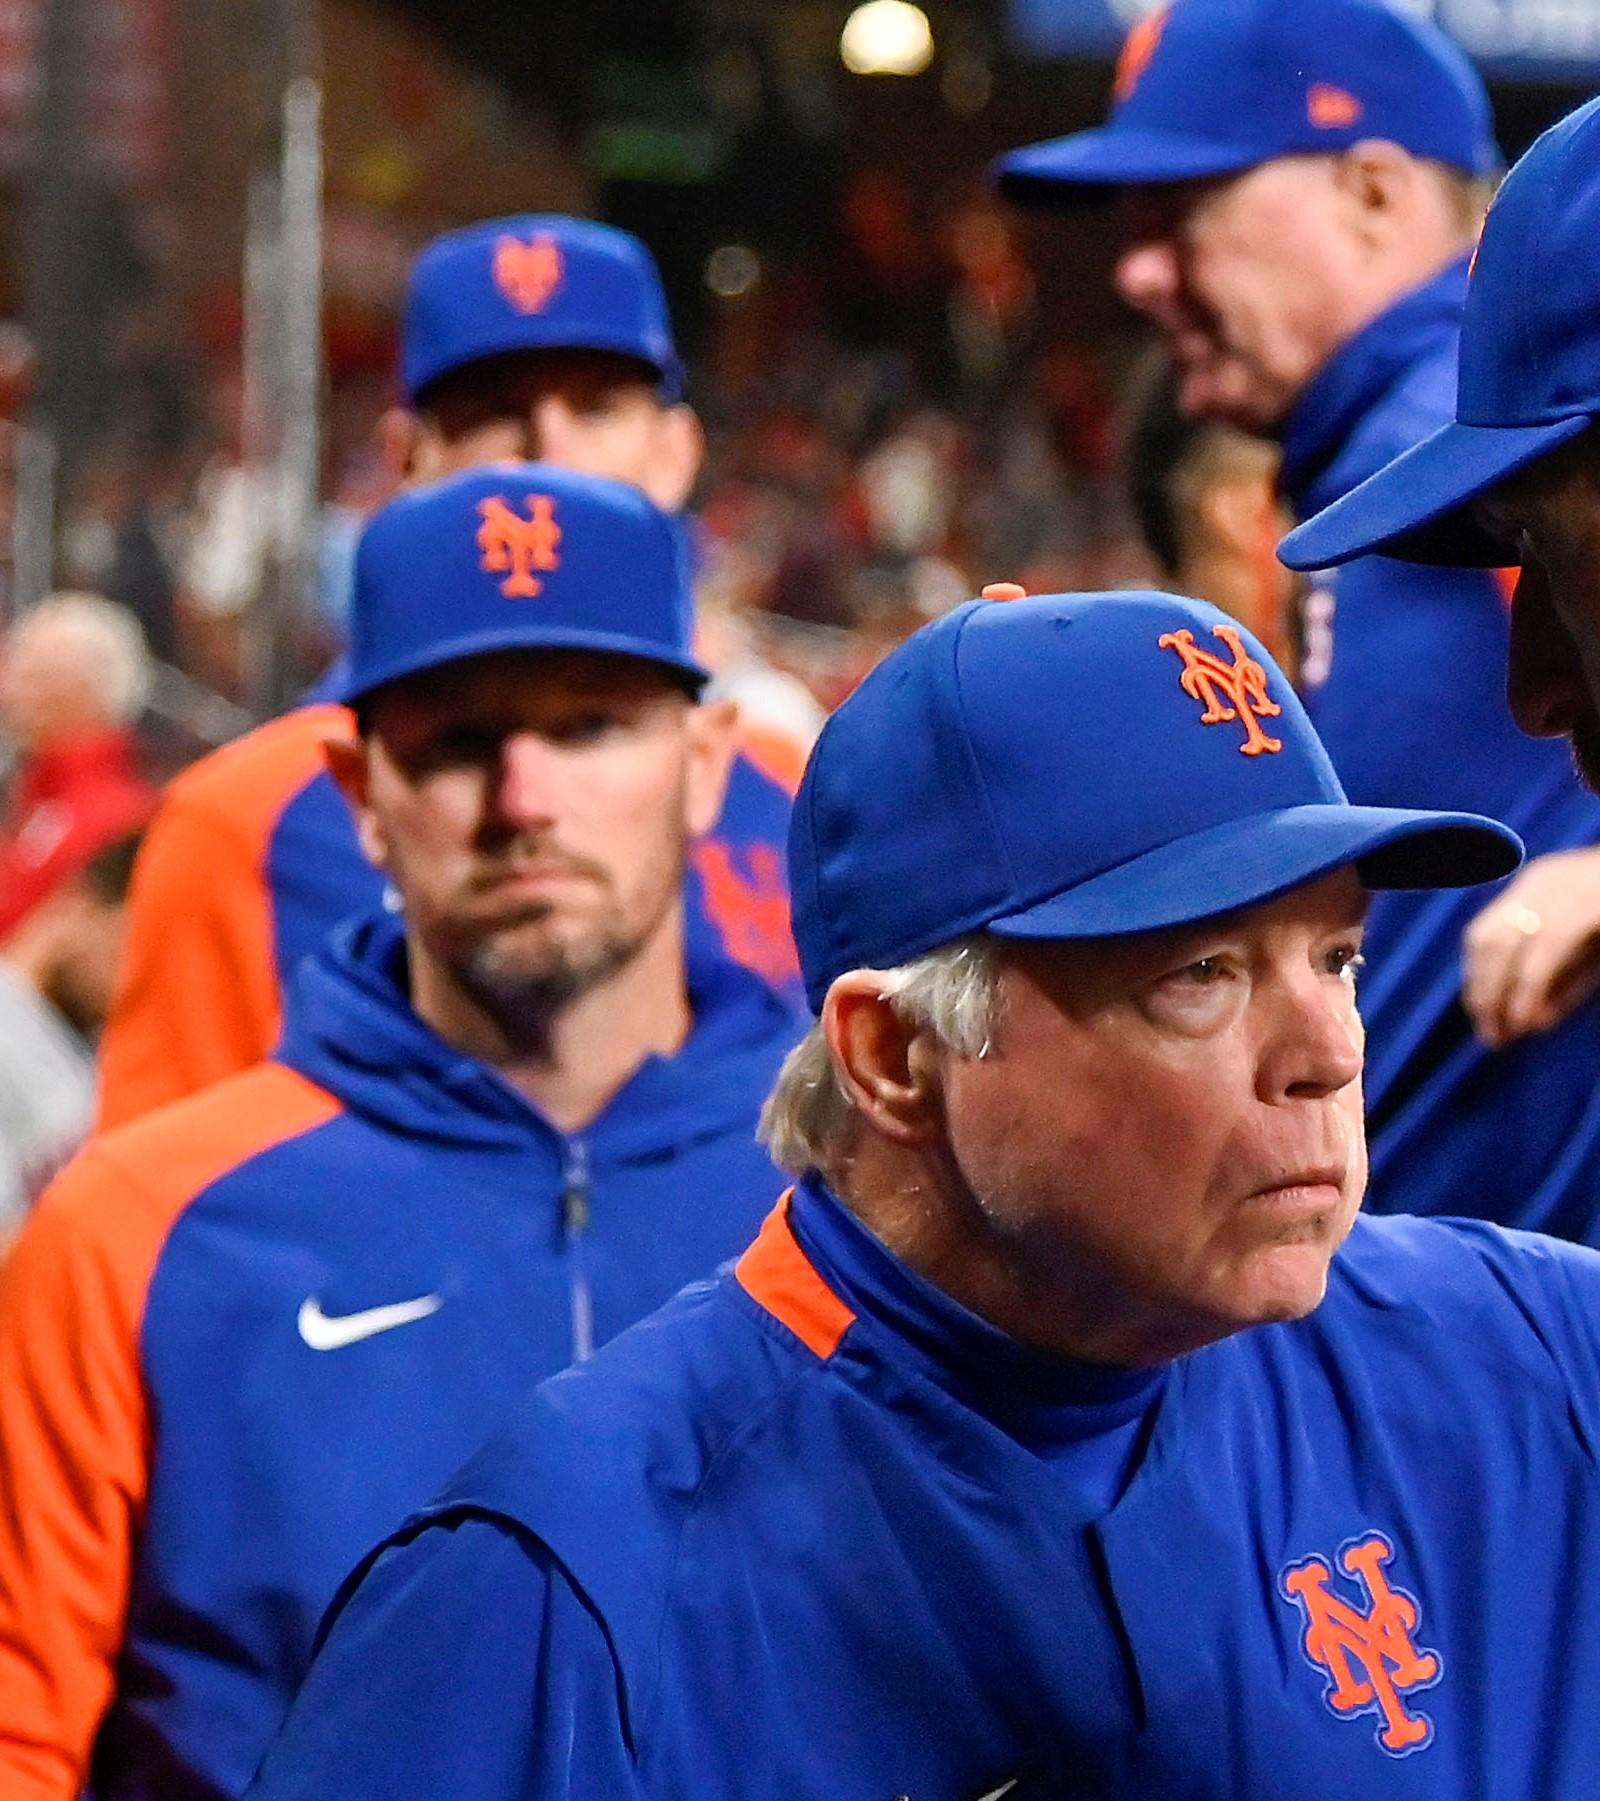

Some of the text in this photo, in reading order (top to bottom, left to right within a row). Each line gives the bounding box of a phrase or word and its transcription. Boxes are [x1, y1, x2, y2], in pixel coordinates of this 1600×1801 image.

[477, 495, 562, 596] NY
[1158, 624, 1282, 756] NY
[1279, 1531, 1443, 1758] NY
